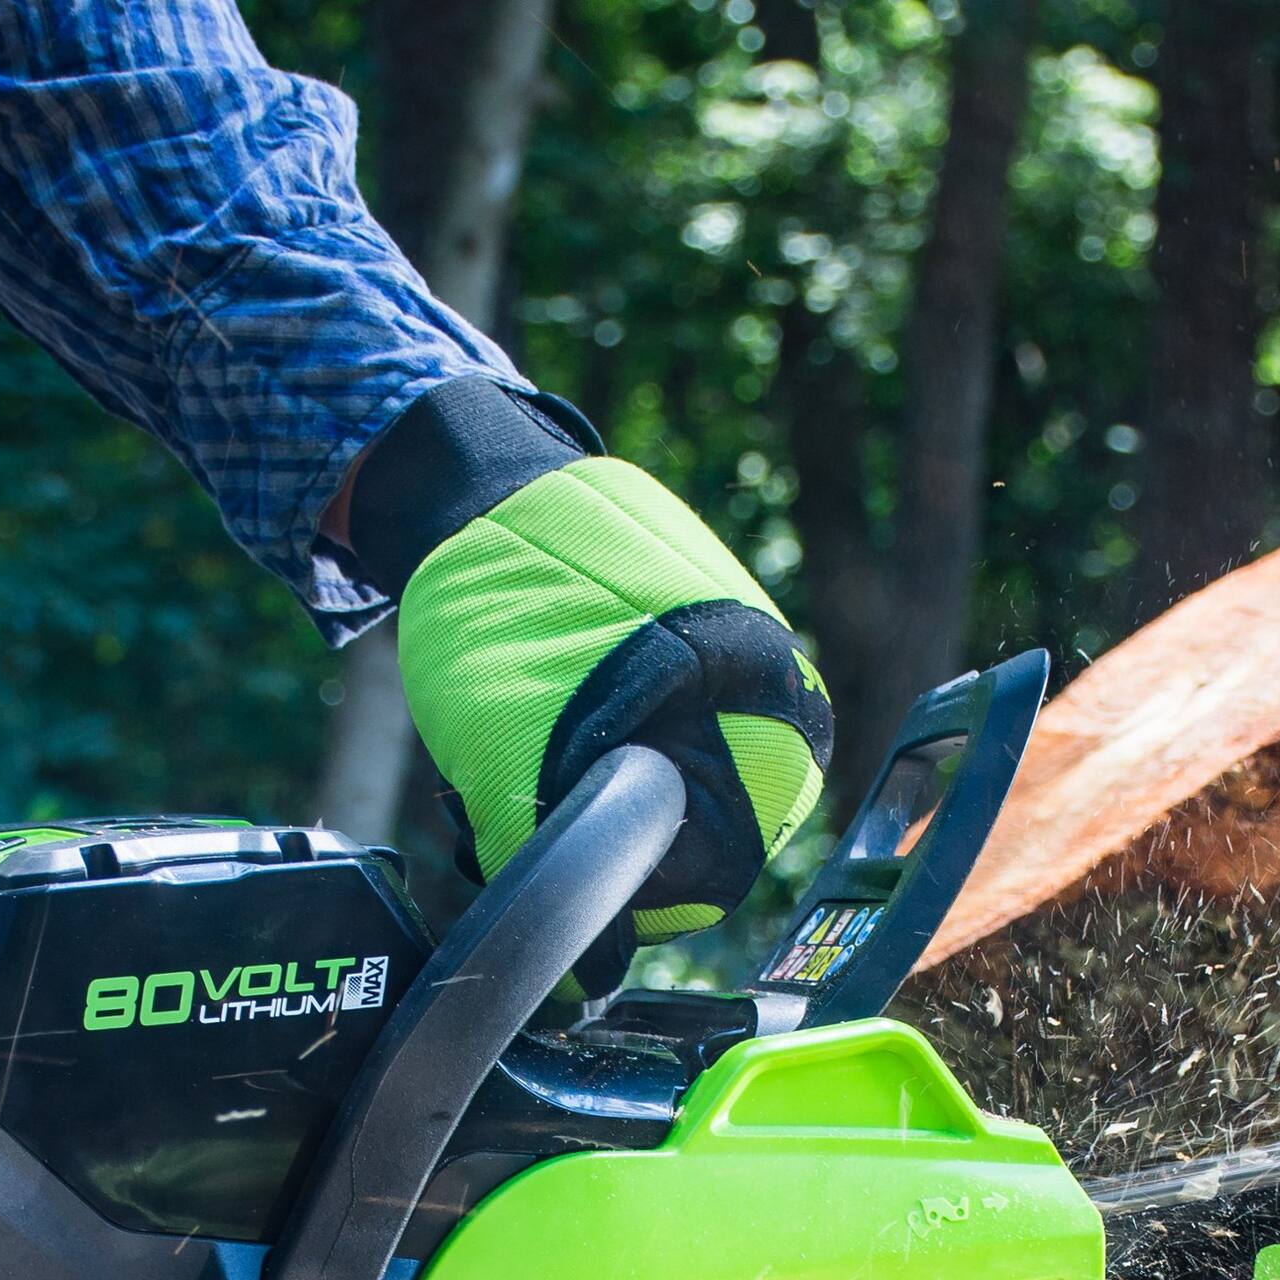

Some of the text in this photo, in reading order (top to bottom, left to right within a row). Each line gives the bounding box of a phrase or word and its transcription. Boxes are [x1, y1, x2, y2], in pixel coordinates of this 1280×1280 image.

[83, 957, 356, 1031] 80 VOLT
[361, 958, 386, 1006] MAX
[199, 992, 336, 1024] LITHIUM
